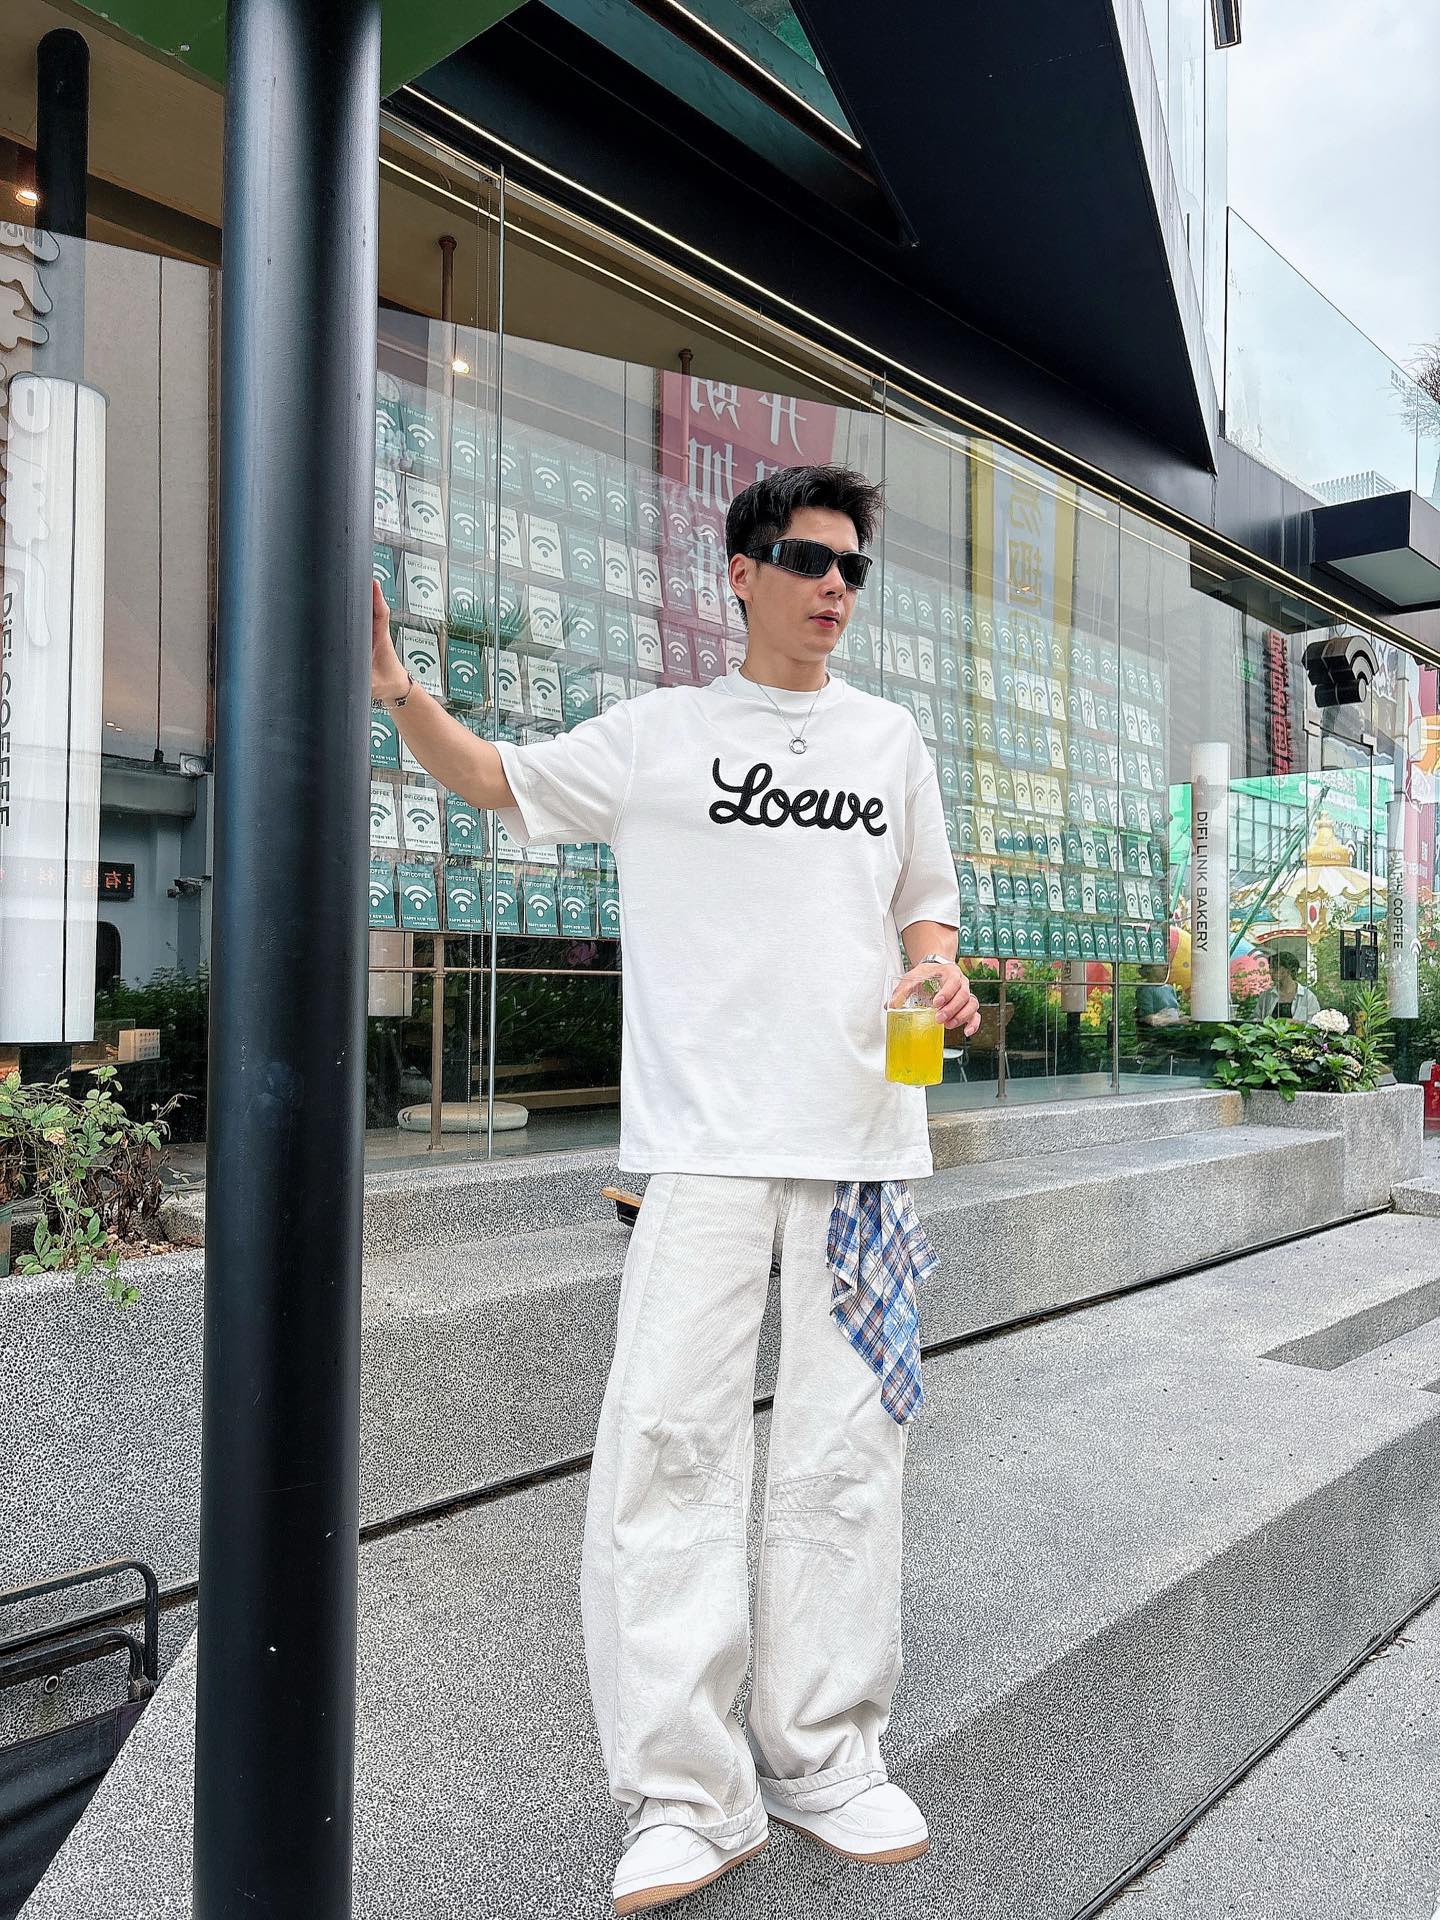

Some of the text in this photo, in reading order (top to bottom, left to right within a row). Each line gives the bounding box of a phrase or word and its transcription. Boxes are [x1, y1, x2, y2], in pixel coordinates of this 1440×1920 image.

[709, 758, 888, 836] Loewe
[1197, 845, 1208, 882] LINK
[1197, 887, 1208, 952] BAKERY
[1393, 898, 1403, 949] COFFEE
